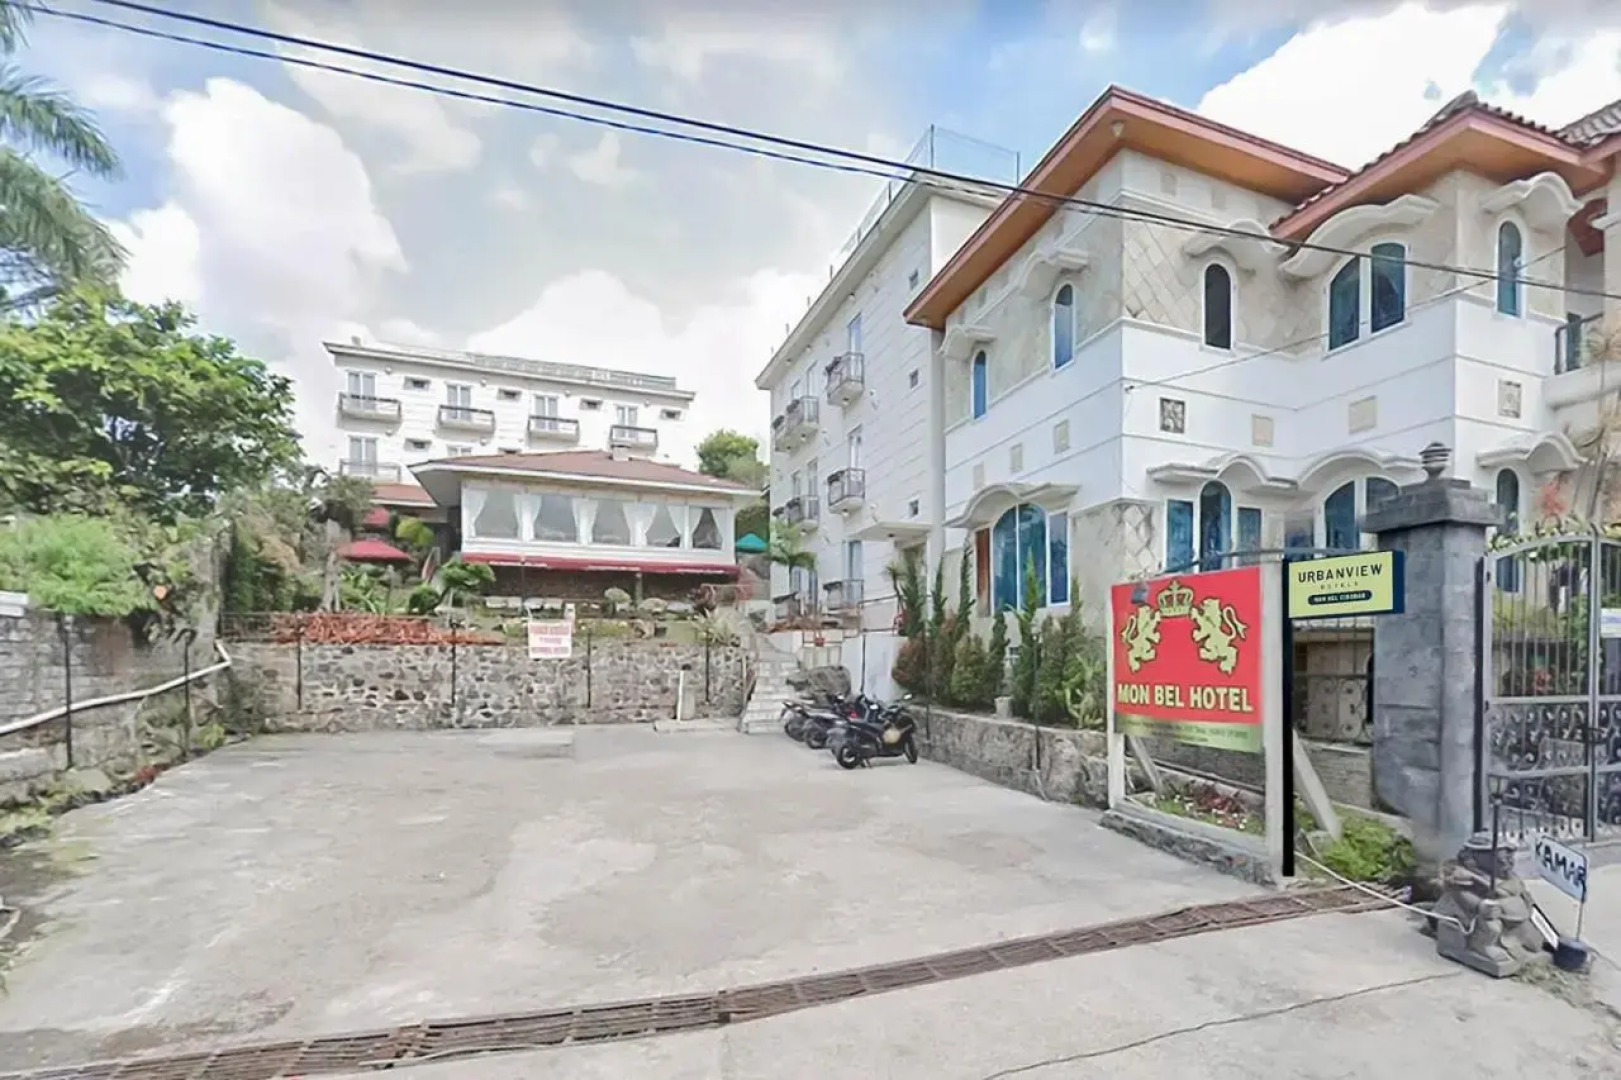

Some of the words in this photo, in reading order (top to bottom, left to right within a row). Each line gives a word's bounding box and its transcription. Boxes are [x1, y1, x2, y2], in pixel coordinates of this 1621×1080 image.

[1298, 564, 1382, 583] URBANVIEW
[1117, 683, 1149, 704] MON
[1154, 684, 1184, 707] BEL
[1189, 686, 1253, 712] HOTEL
